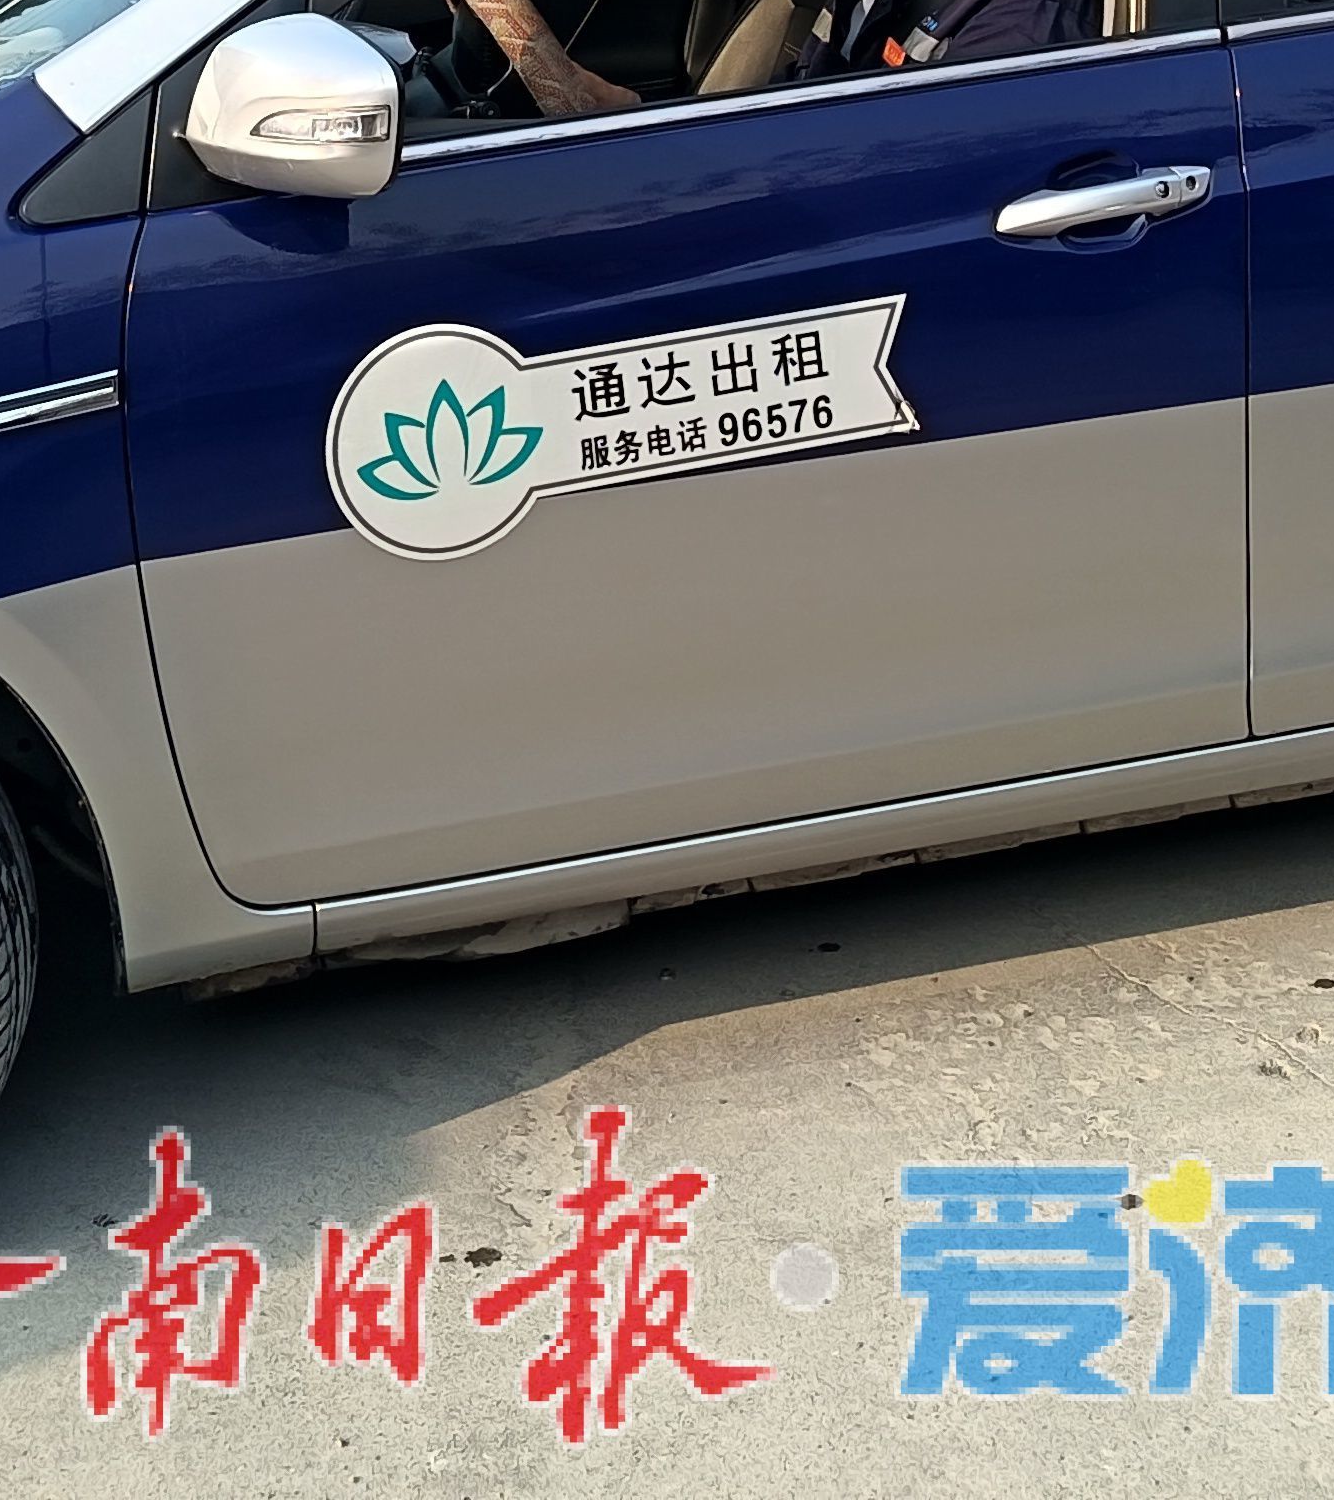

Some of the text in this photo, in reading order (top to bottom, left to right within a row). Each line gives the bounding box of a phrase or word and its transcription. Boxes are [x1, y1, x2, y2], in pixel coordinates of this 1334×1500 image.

[571, 330, 830, 421] 通达出租
[580, 394, 834, 470] 服务电话 96576
